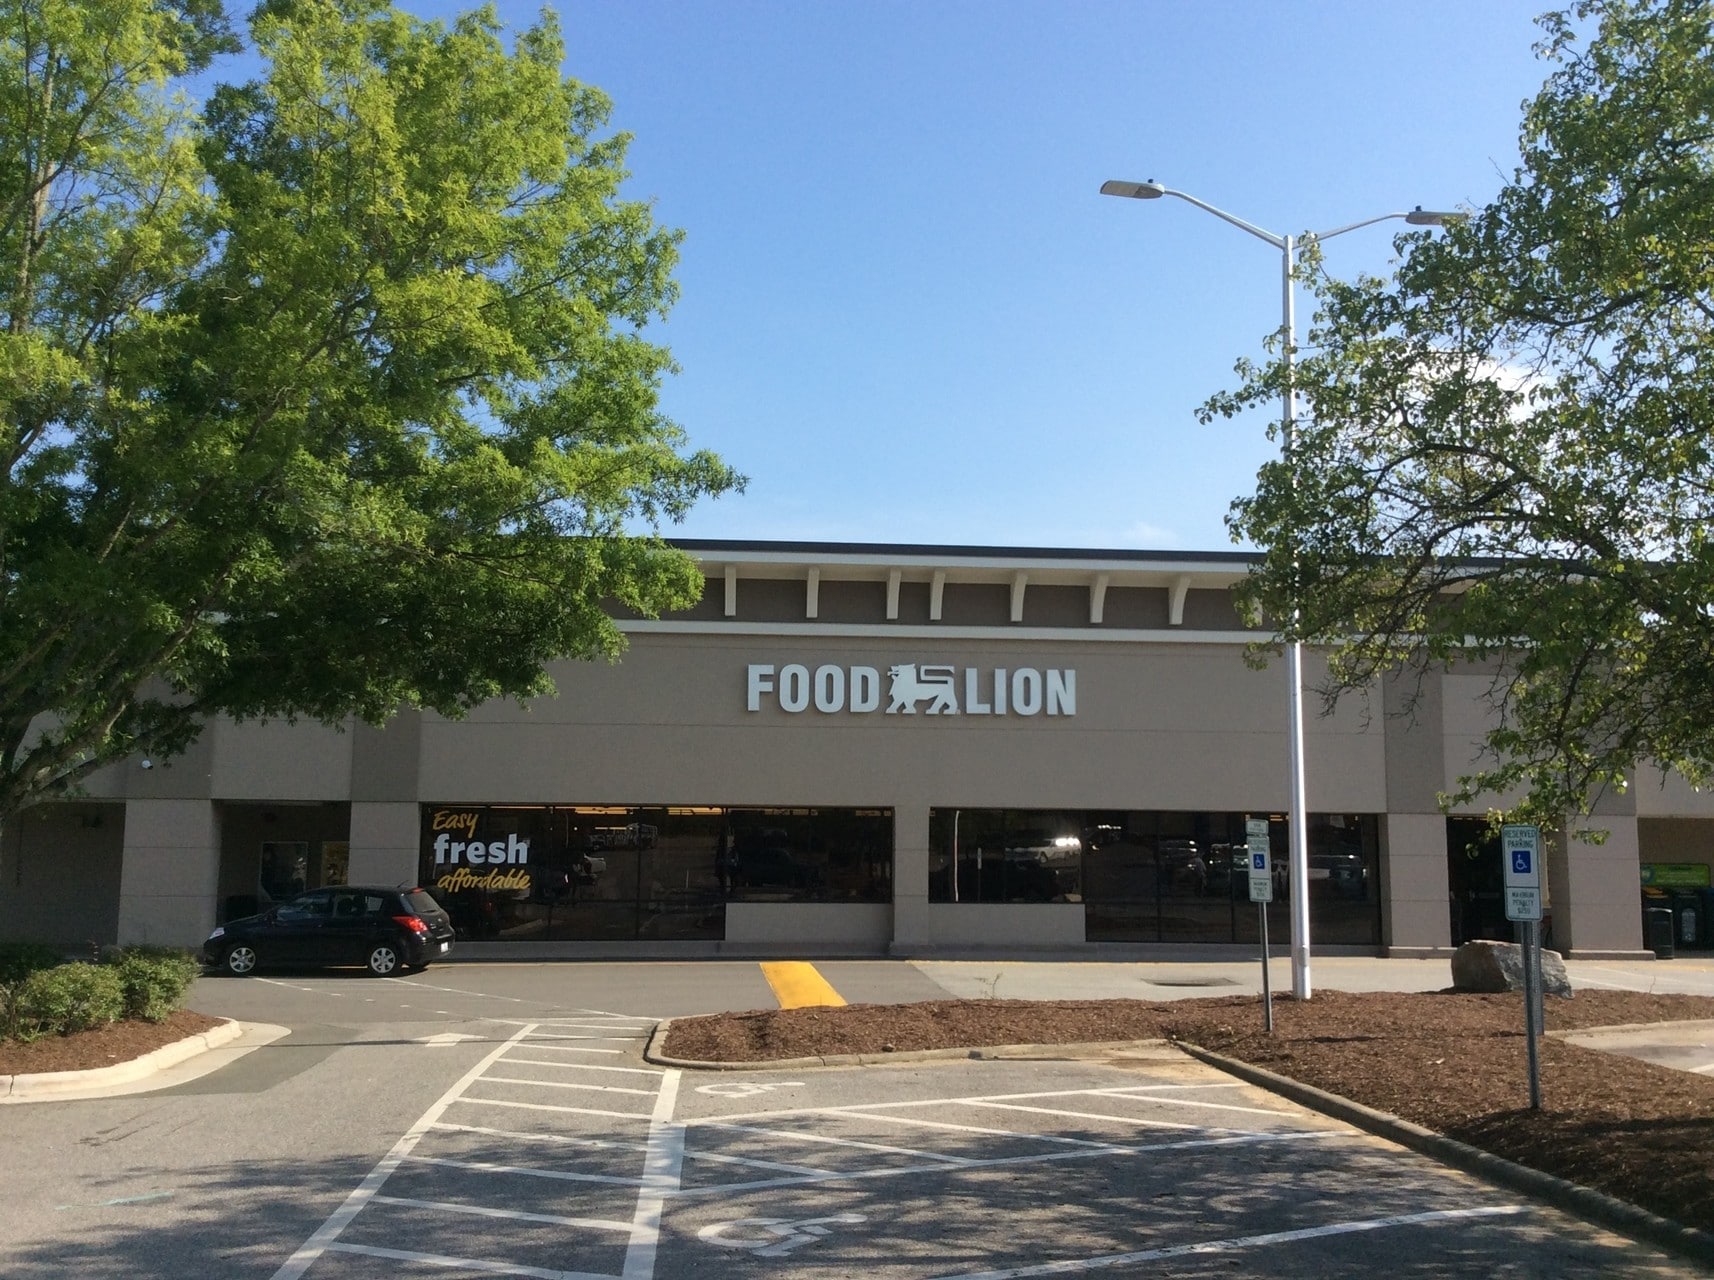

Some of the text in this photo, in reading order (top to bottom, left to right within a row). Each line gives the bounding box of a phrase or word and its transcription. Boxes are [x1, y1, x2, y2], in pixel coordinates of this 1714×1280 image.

[747, 663, 1076, 716] FOOD LION
[432, 810, 479, 839] Easy
[433, 833, 528, 864] fresh
[1507, 840, 1533, 849] PARKING
[436, 867, 531, 893] affordable
